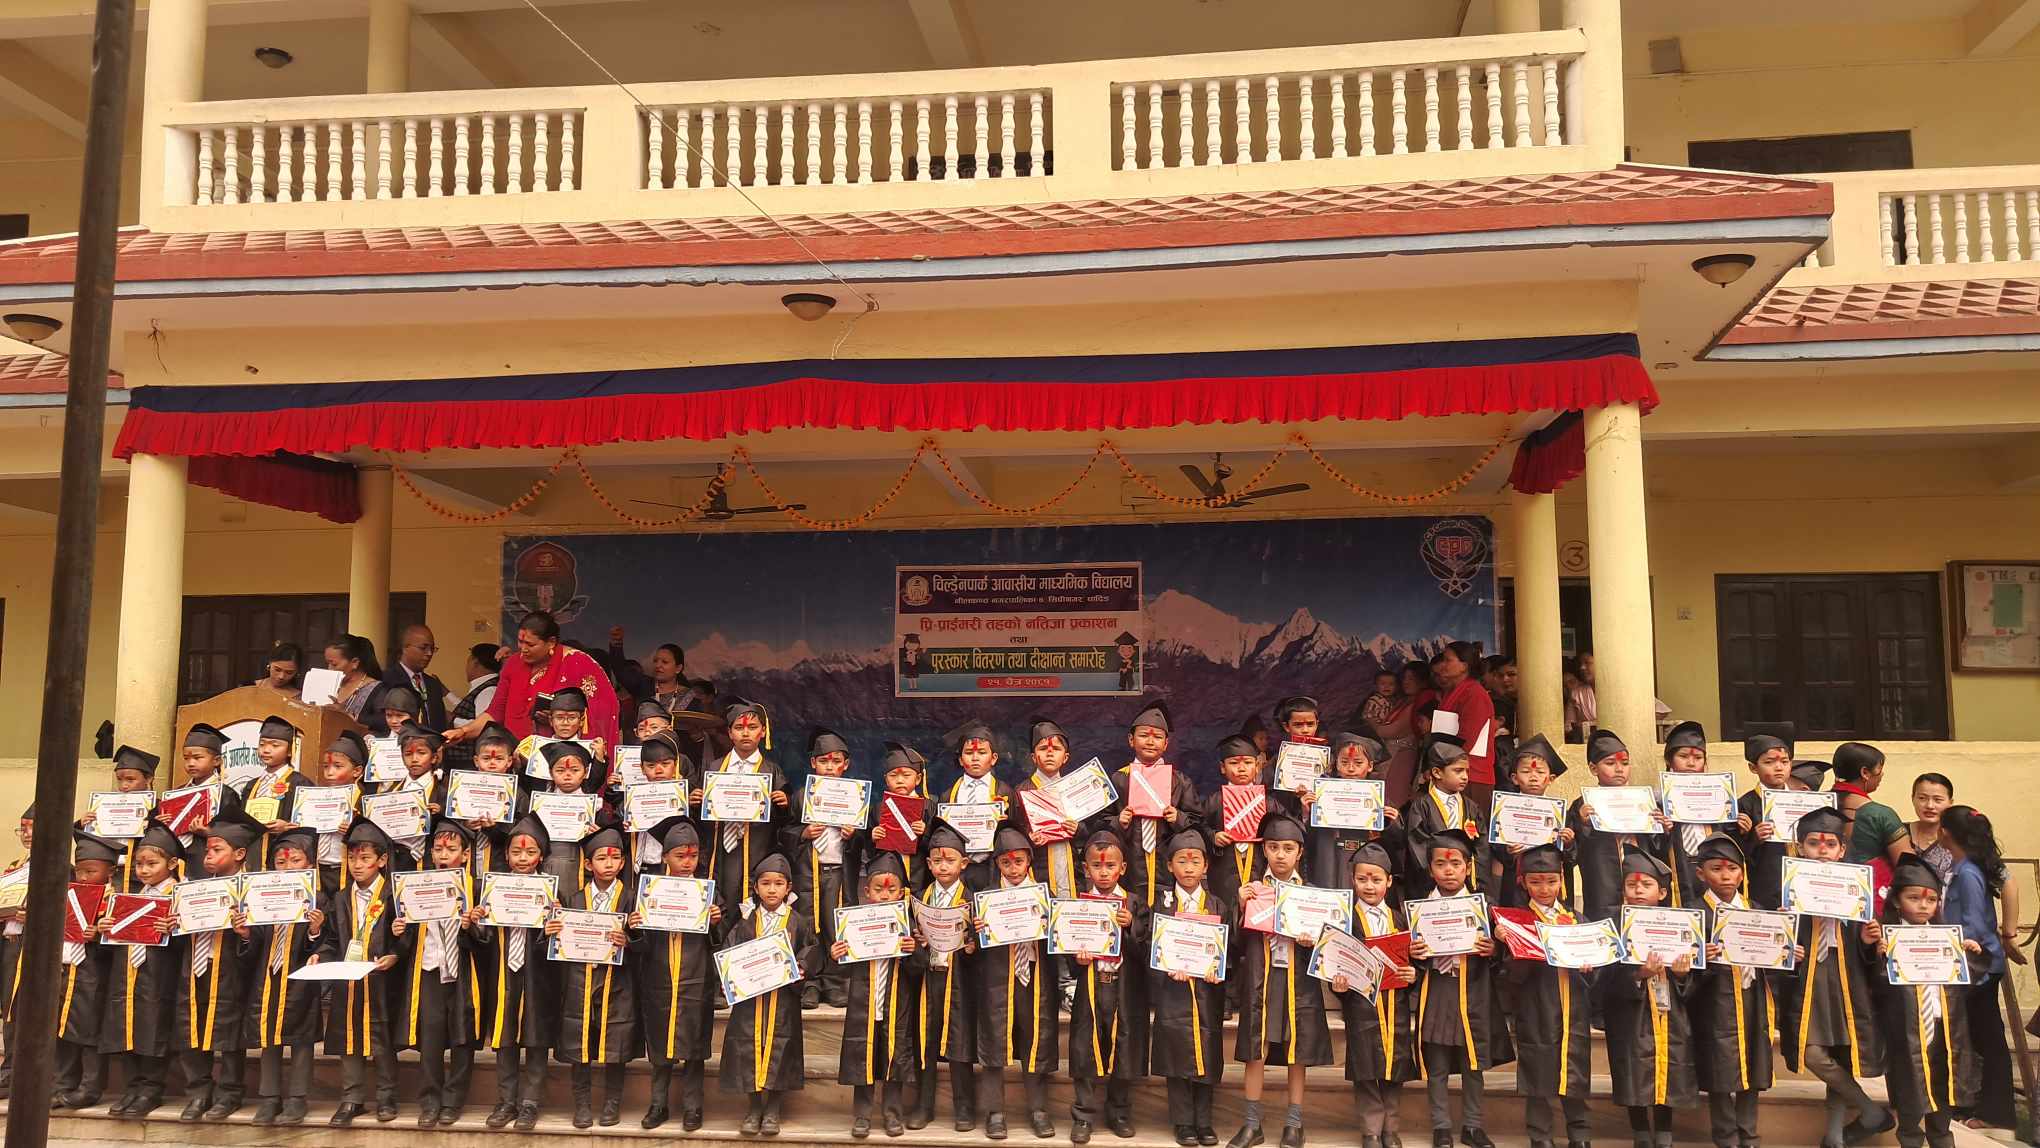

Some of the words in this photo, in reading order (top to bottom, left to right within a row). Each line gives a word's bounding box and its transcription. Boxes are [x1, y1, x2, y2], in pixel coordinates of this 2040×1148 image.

[1567, 546, 1585, 567] 3
[991, 574, 1036, 592] आवासीय
[1039, 572, 1089, 590] माध्यमिक
[1091, 571, 1134, 590] विद्यालय
[985, 616, 1021, 631] तहको
[1025, 615, 1065, 630] नतिजा
[1069, 616, 1118, 630] प्रकाशन
[1009, 635, 1028, 645] तथा
[931, 652, 970, 674] पुरस्कार
[972, 648, 1006, 671] वितरण
[1007, 651, 1028, 670] तथा
[1029, 647, 1066, 671] दीक्षान्त
[1069, 647, 1106, 670] समारोह
